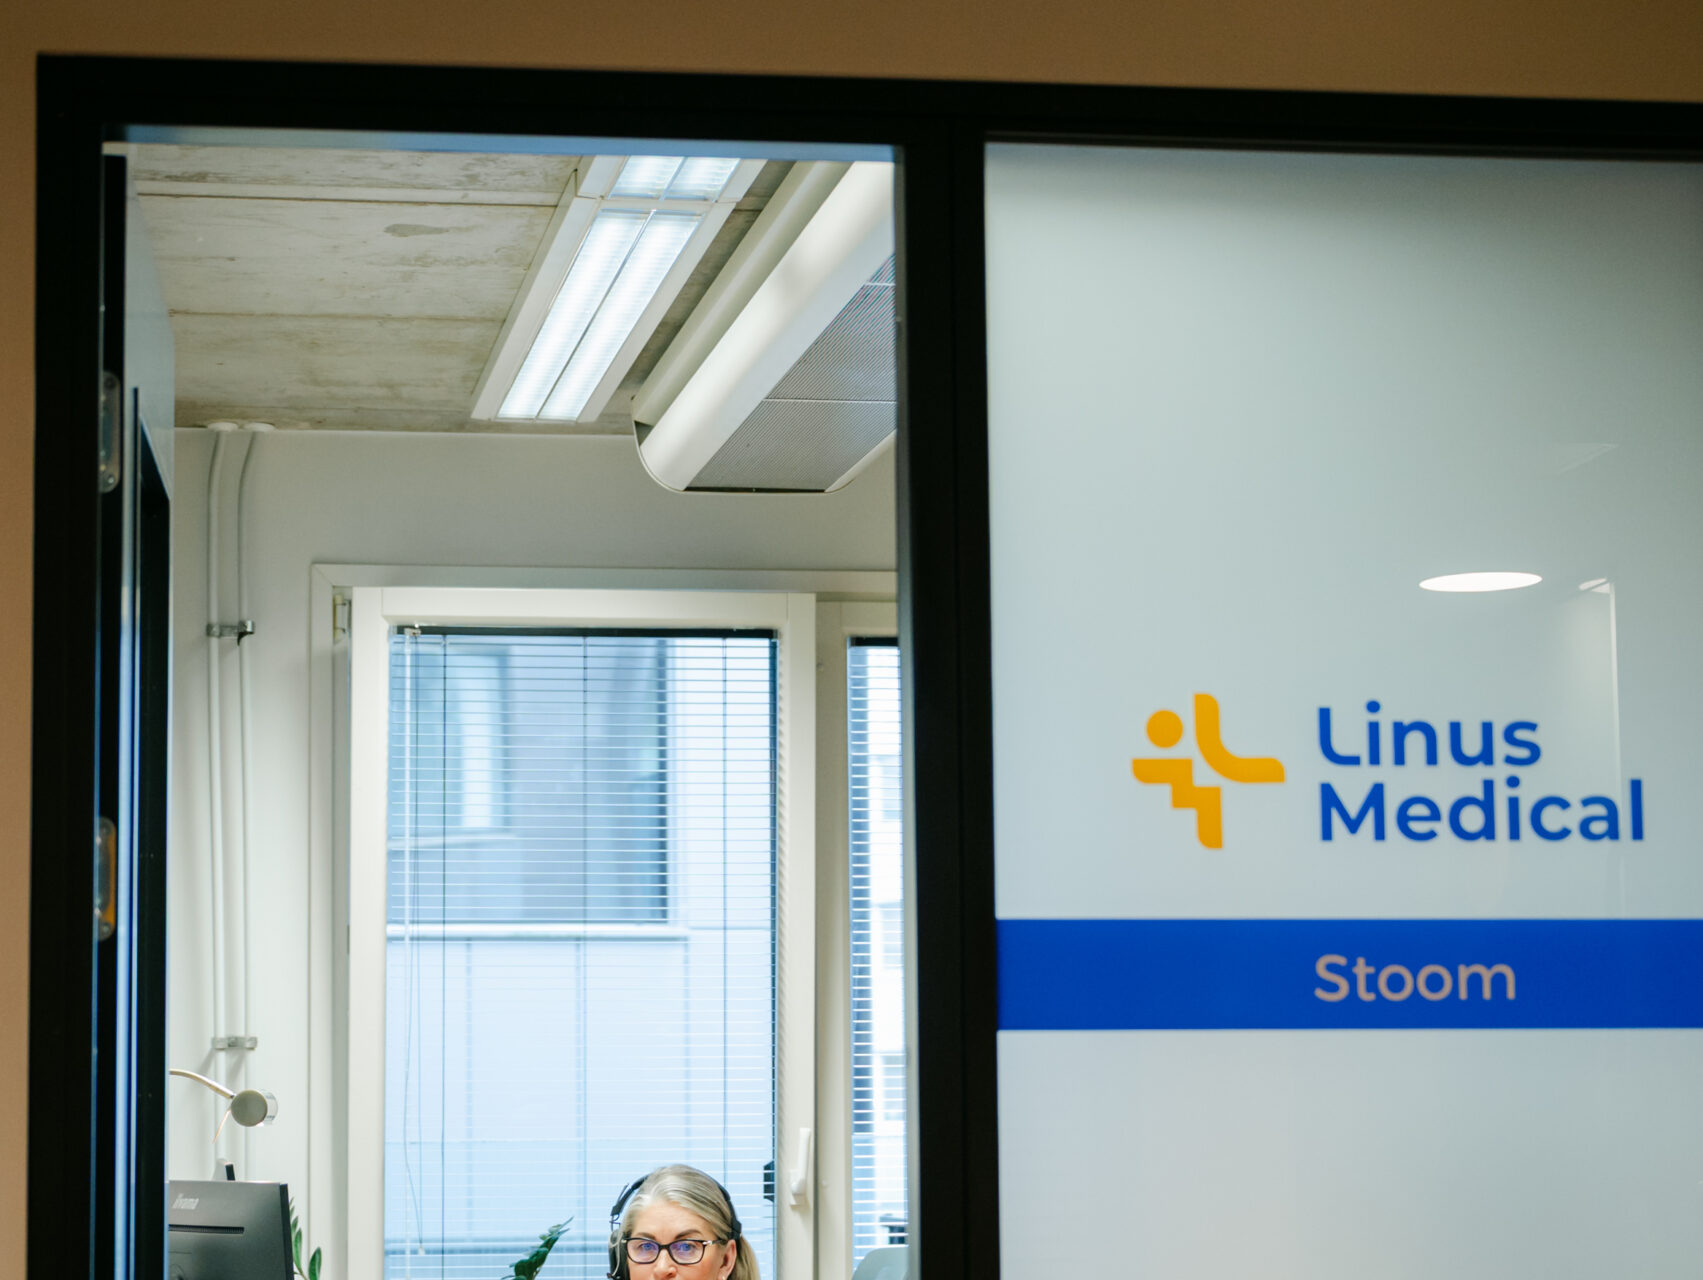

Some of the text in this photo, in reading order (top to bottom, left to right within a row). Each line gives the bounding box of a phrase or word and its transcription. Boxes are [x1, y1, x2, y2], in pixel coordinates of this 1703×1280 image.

[1317, 700, 1542, 767] Linus
[1320, 775, 1645, 842] Medical
[1313, 953, 1517, 1003] Stoom
